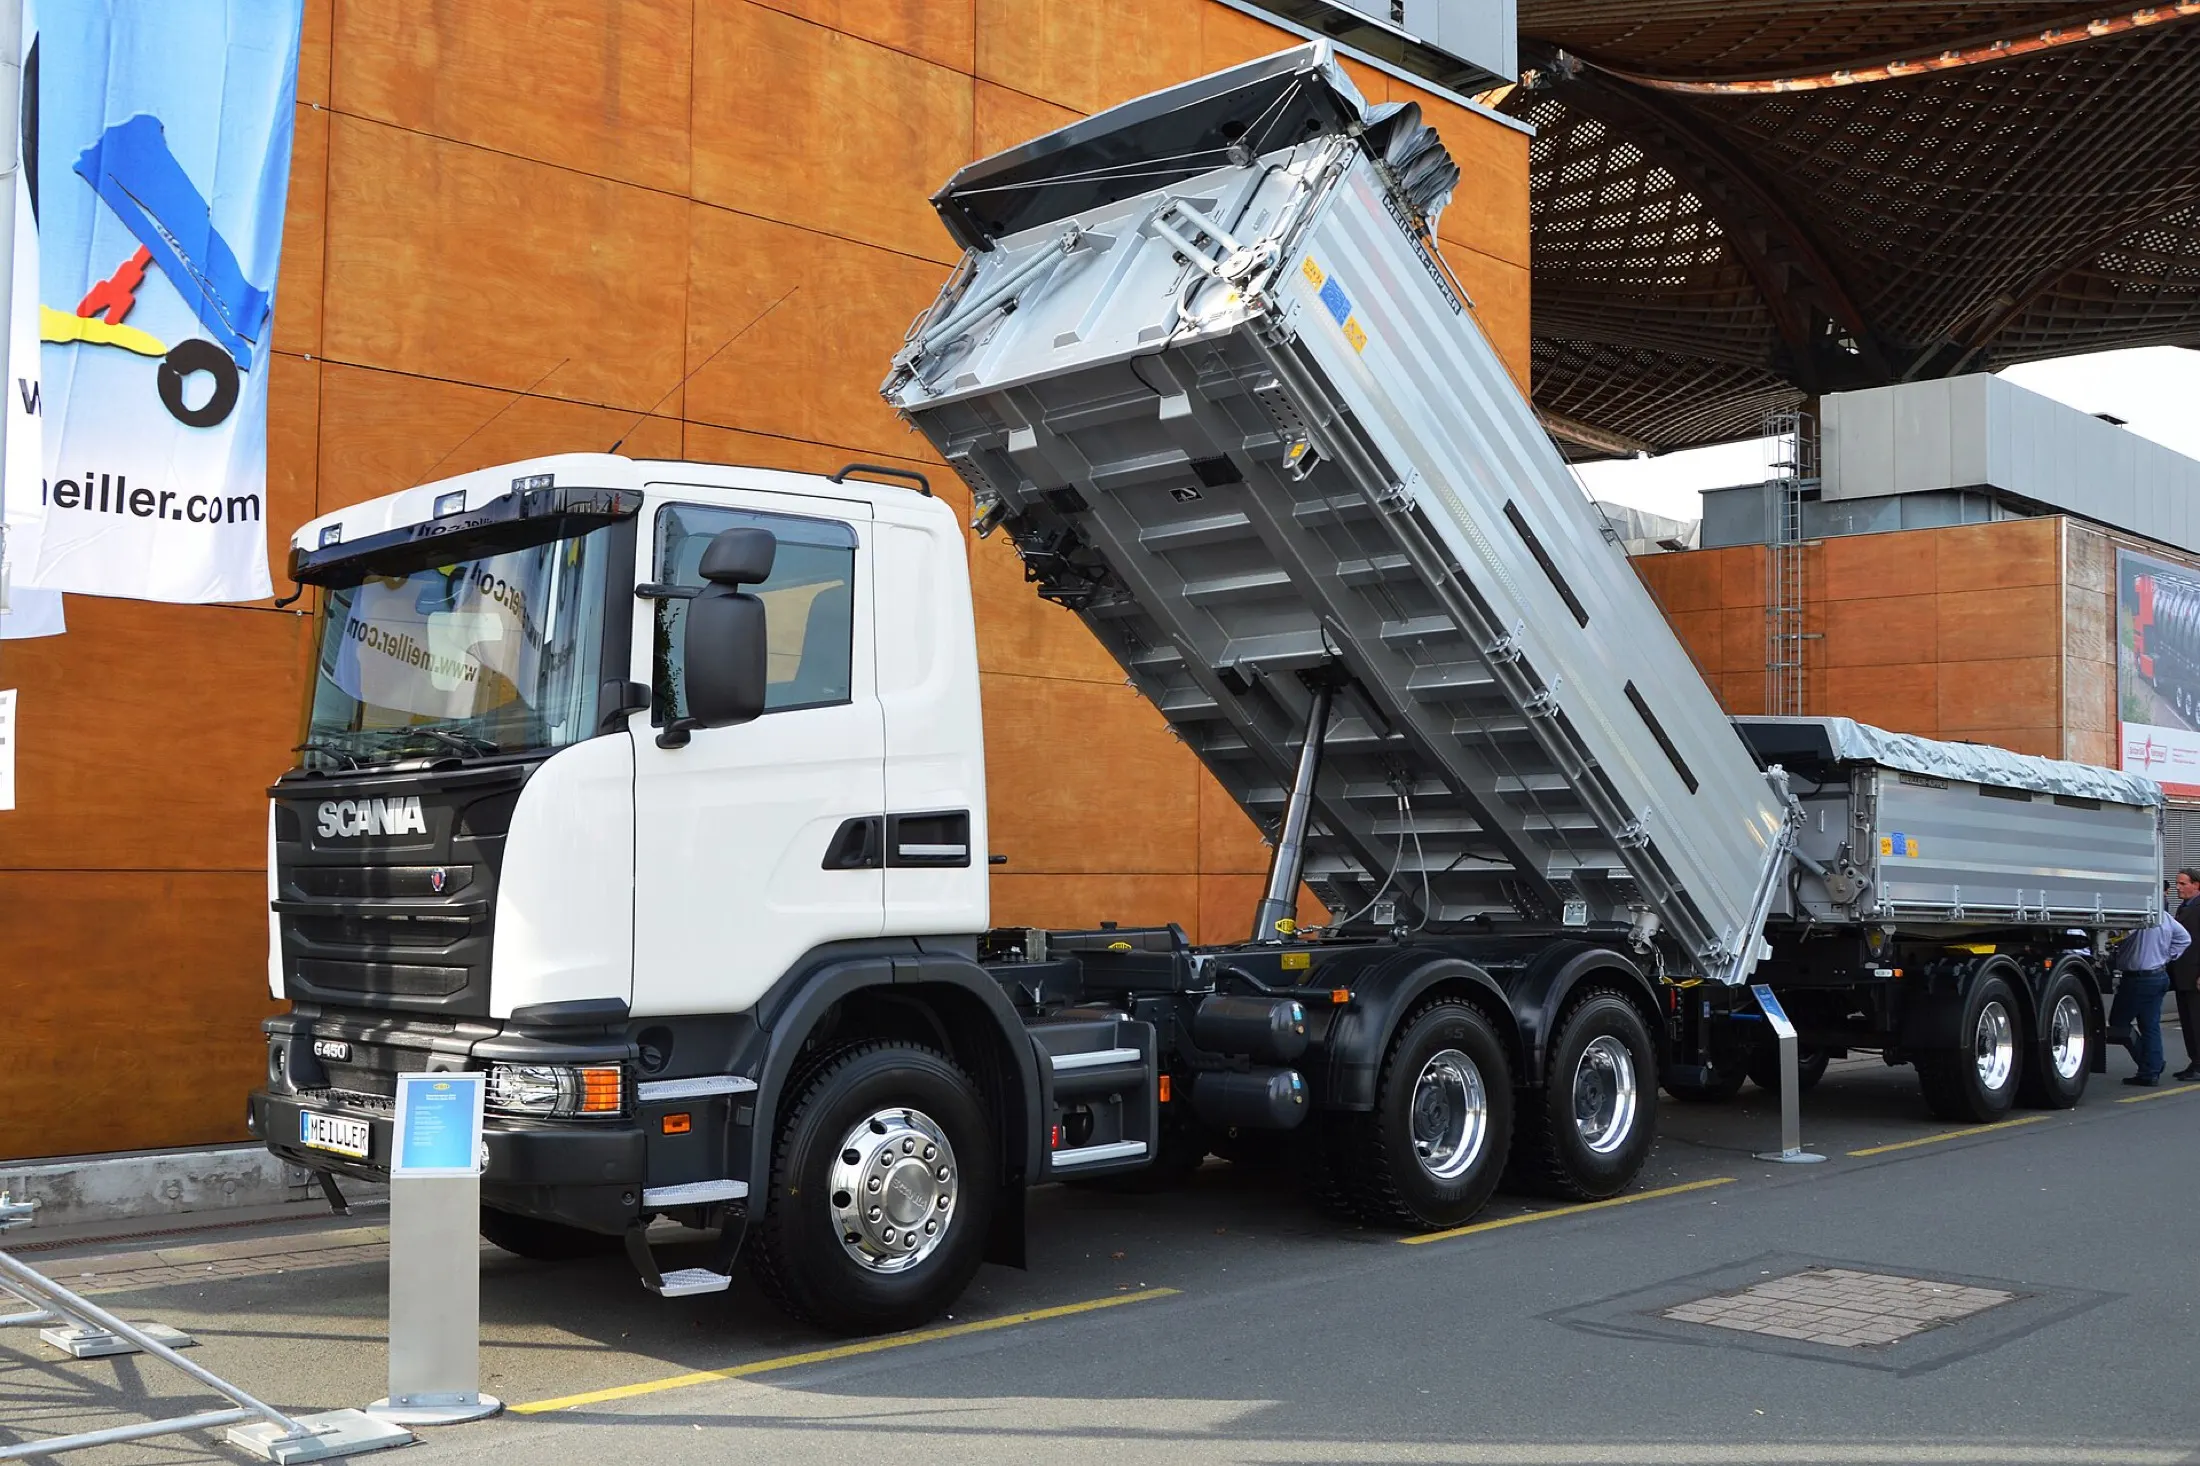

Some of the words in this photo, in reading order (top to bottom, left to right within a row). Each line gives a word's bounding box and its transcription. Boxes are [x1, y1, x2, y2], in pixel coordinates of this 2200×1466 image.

[1384, 196, 1460, 313] MEILLER-KIPPER
[42, 472, 260, 524] eiller.com
[317, 796, 427, 838] SCANIA
[314, 1041, 323, 1056] G
[322, 1044, 346, 1059] 450
[311, 1119, 367, 1151] MEILLER
